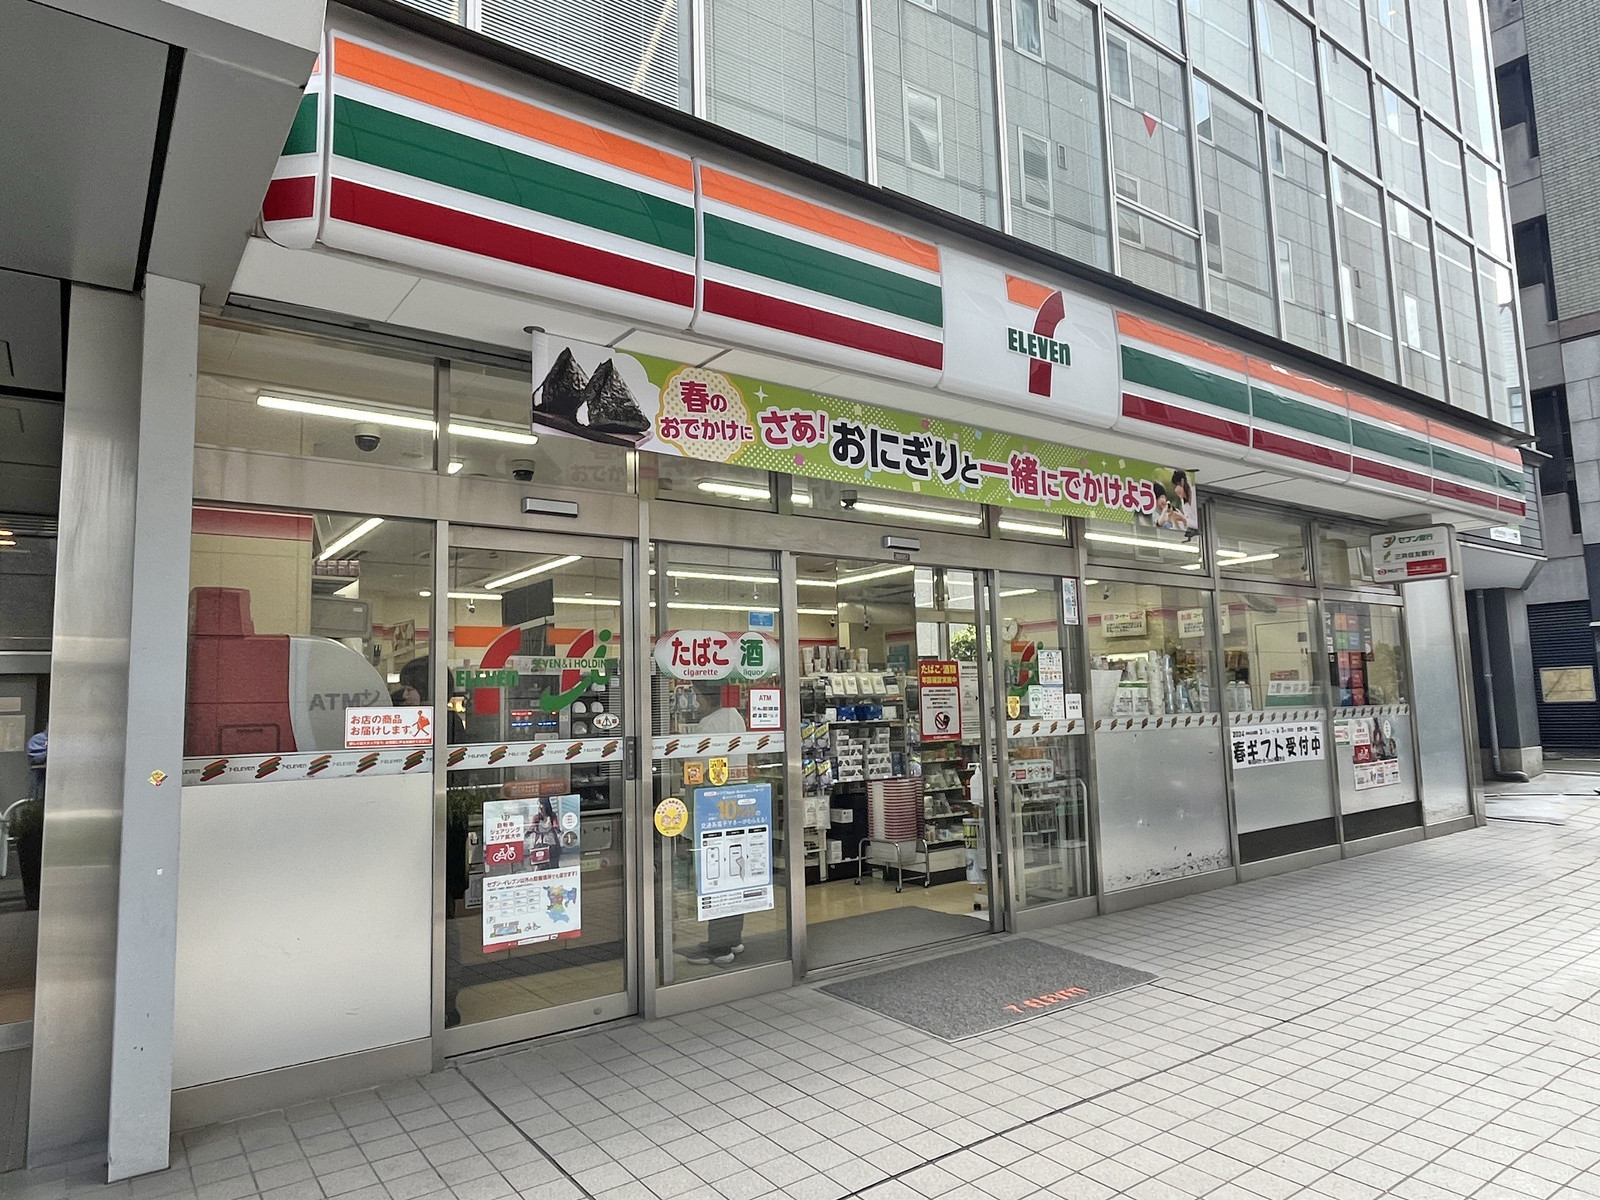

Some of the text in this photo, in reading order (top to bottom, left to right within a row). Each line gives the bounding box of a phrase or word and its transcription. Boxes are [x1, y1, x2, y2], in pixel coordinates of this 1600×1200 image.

[679, 381, 727, 413] 春の
[660, 416, 754, 442] おでかけに
[671, 637, 764, 667] たばこ 酒
[683, 668, 765, 677] cigarette liquor
[350, 714, 403, 725] お店の商品
[1232, 735, 1321, 763] 春ギフト受付中
